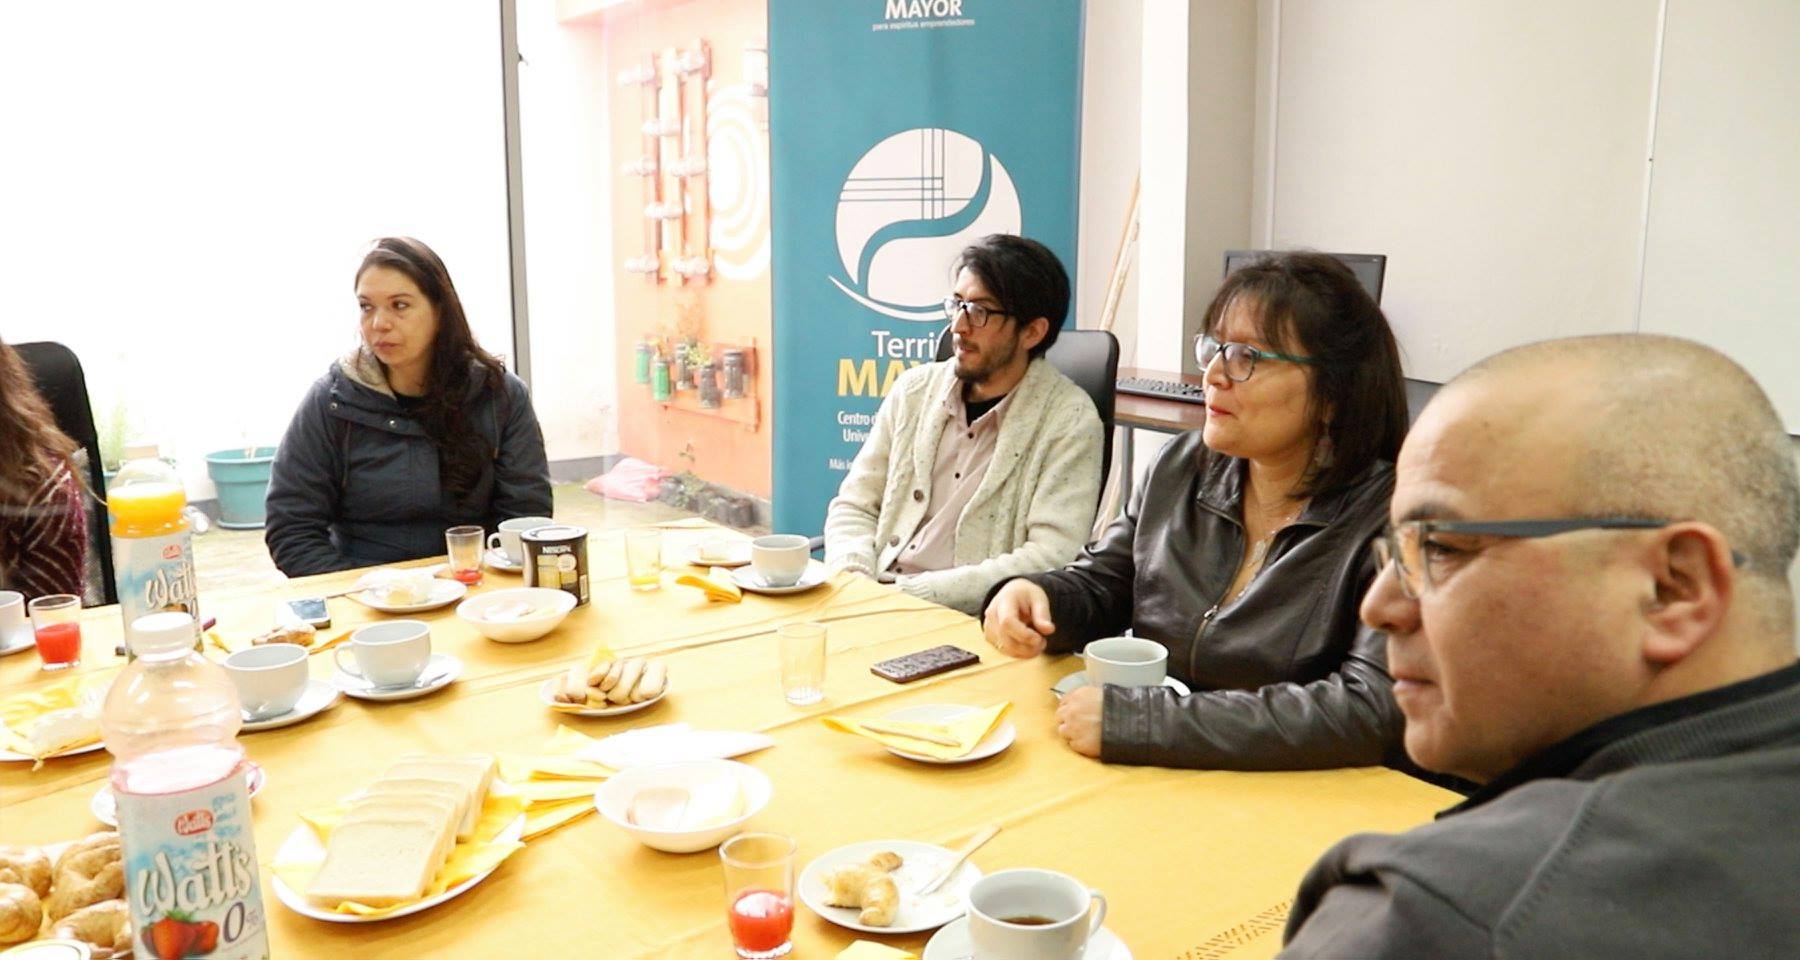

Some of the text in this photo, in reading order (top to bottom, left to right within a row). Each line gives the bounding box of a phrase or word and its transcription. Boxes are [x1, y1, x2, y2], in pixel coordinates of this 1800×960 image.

[885, 0, 962, 19] MAYOR
[871, 331, 940, 358] Terri
[837, 411, 870, 425] Centro
